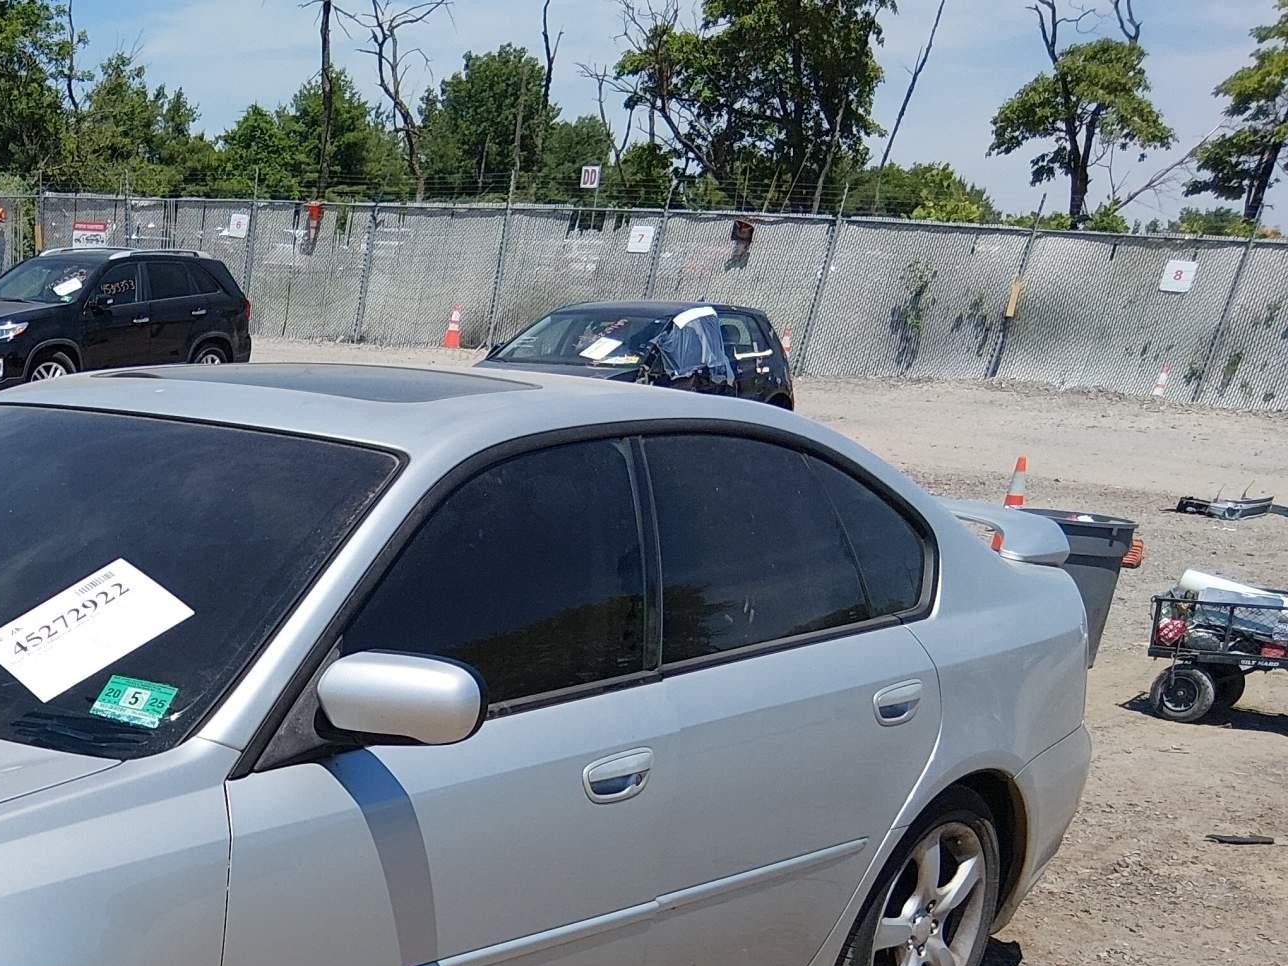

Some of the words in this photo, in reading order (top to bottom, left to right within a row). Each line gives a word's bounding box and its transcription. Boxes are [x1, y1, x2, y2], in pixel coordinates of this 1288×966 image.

[582, 168, 597, 186] DD
[638, 233, 645, 243] 7
[1173, 270, 1183, 281] 8
[14, 582, 130, 655] 45272922
[105, 687, 122, 699] 20
[128, 691, 142, 706] 5
[148, 697, 167, 709] 25
